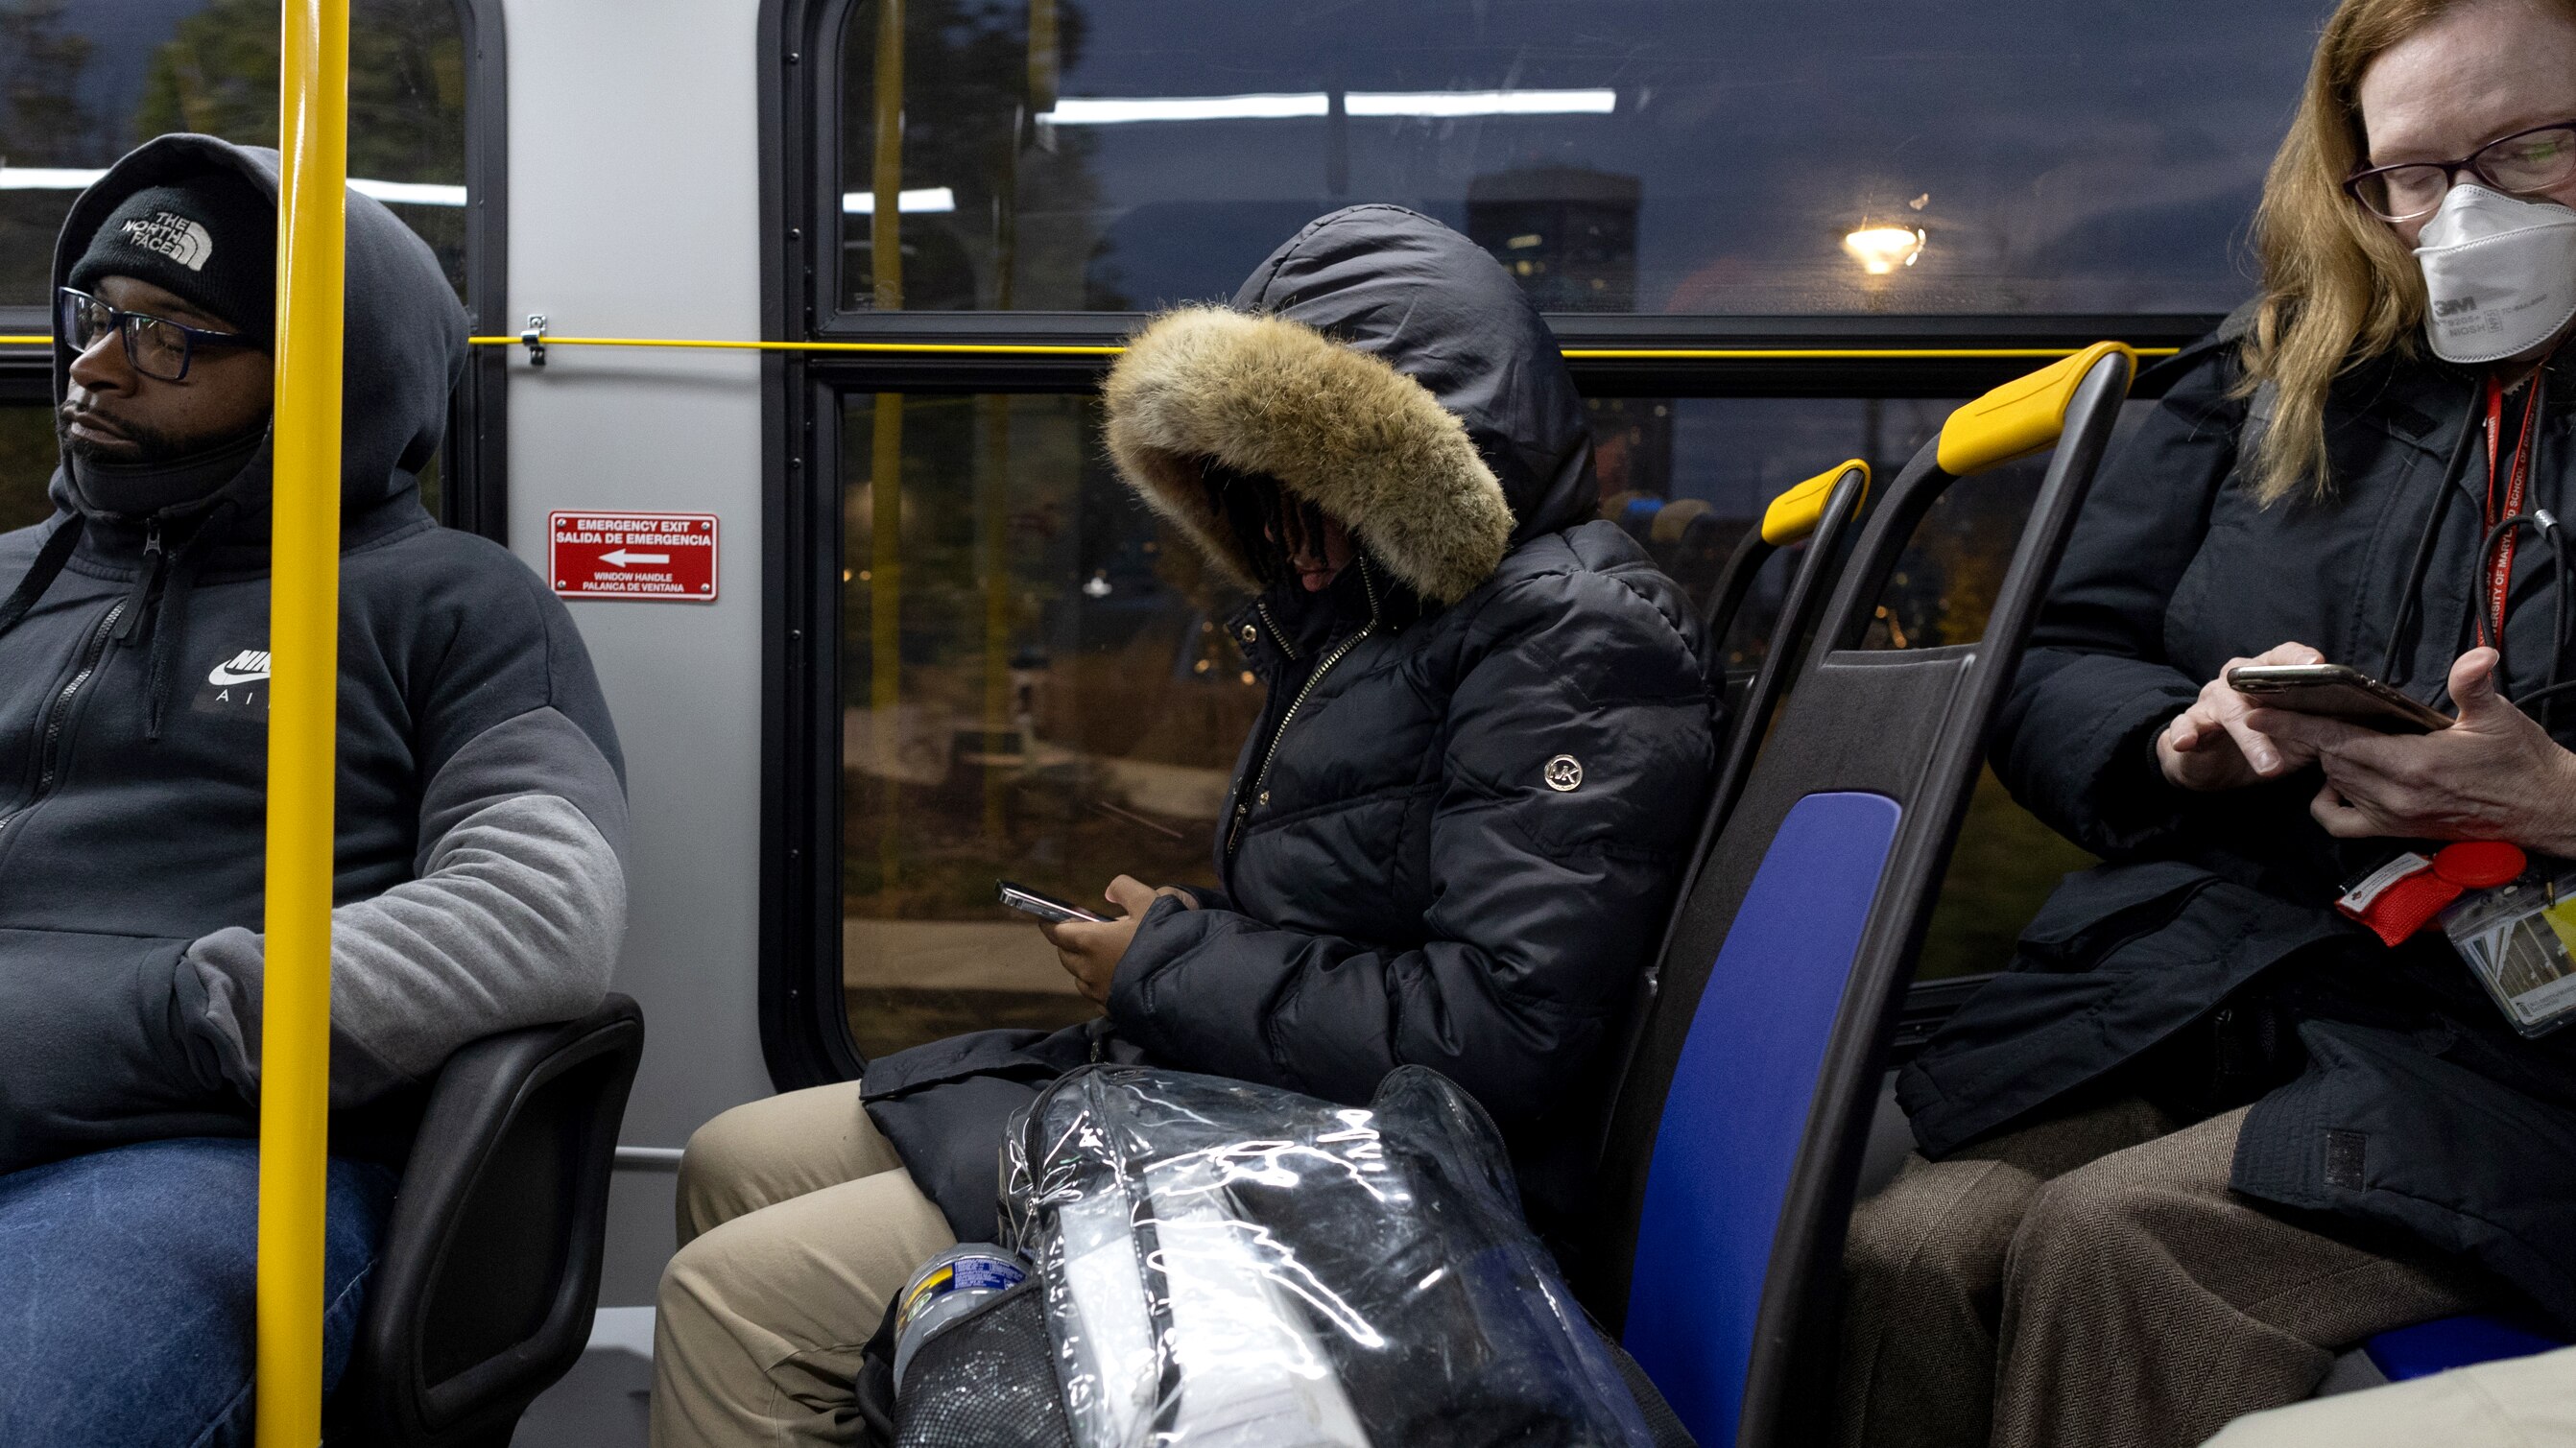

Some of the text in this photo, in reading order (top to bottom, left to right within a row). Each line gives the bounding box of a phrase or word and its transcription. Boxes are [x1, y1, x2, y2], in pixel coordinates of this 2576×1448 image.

[156, 212, 190, 231] THE
[122, 220, 182, 245] NORTH
[131, 231, 175, 254] FACE
[2434, 297, 2477, 318] 3M
[2448, 323, 2487, 338] NIOSH
[2510, 467, 2525, 508] SCHOOL
[577, 519, 690, 533] EMERGENCY EXIT
[556, 532, 712, 546] SALIDA DE EMERGENCIA
[2497, 510, 2516, 568] MARYLD
[583, 582, 684, 592] PALANCA DE VENTANA
[594, 572, 673, 582] WINDOW HANDLE
[2495, 570, 2505, 585] OF
[2491, 587, 2502, 635] VERSITY
[226, 649, 271, 673] NIK
[215, 688, 267, 708] AI
